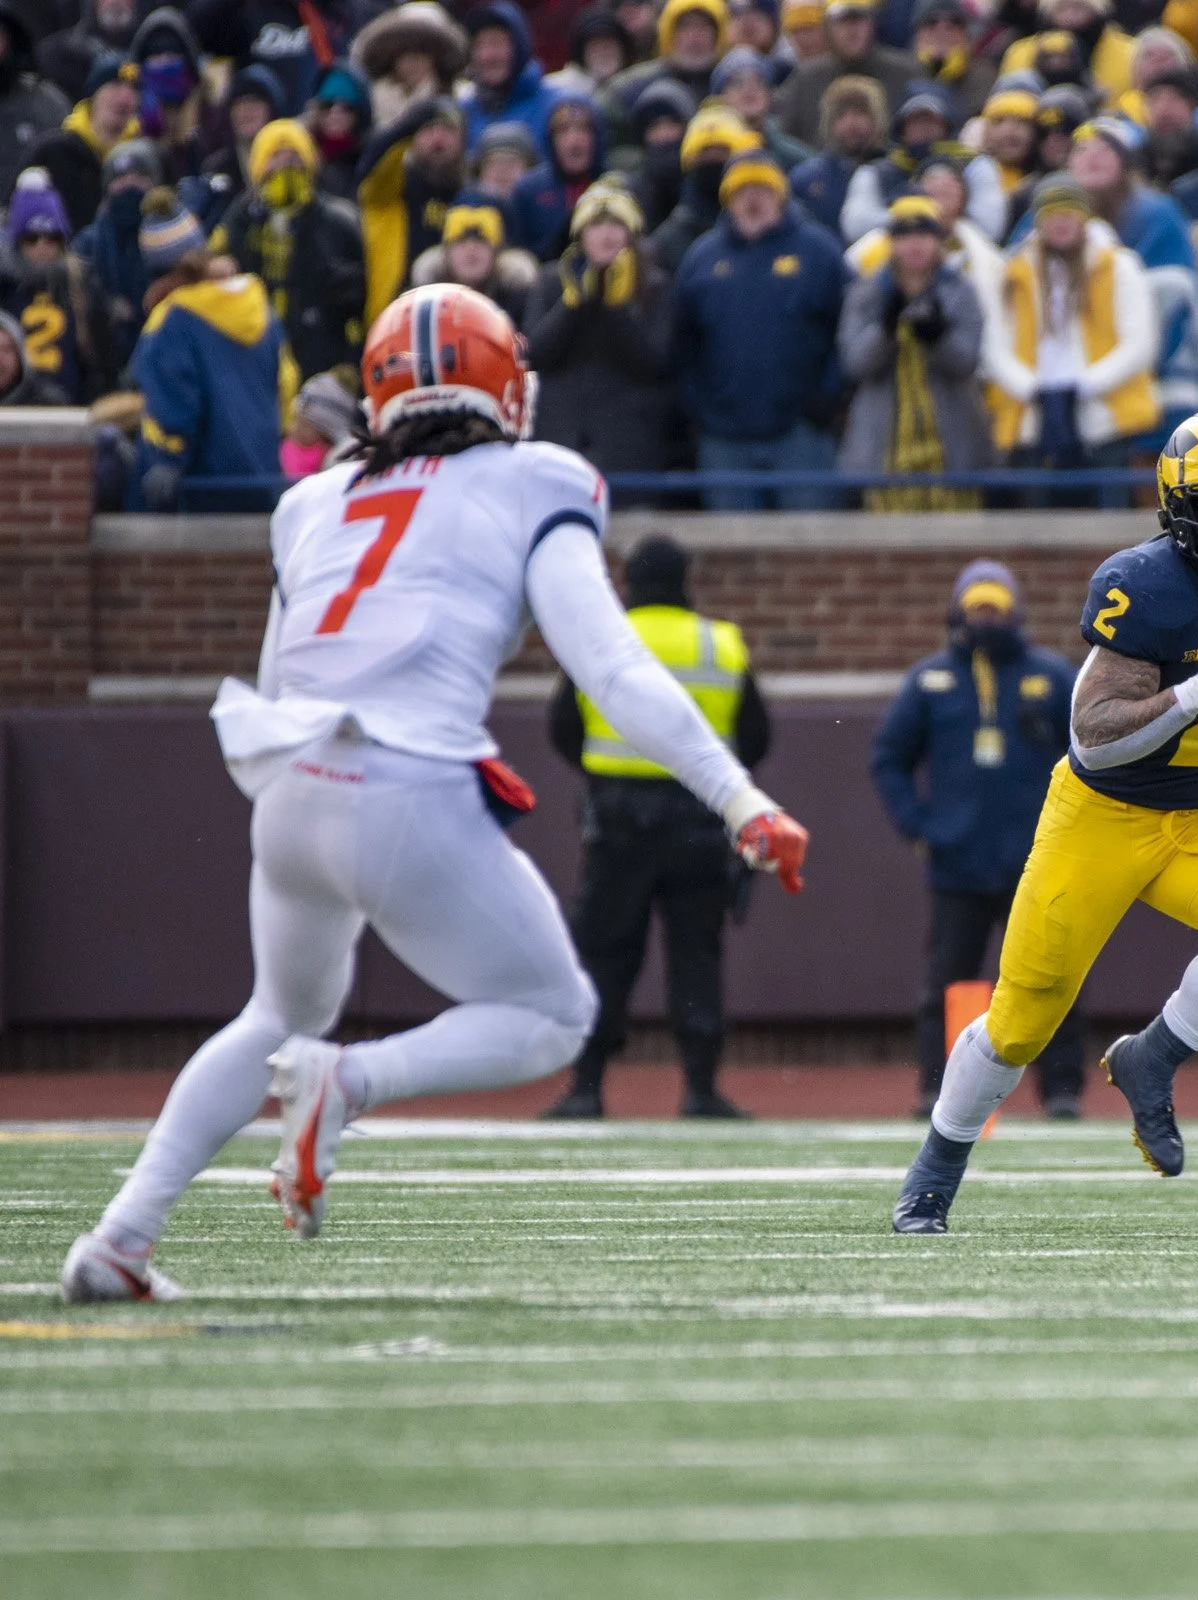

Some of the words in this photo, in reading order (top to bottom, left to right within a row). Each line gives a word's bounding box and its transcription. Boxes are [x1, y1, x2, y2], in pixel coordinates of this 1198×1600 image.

[22, 303, 65, 370] 2
[313, 486, 426, 635] 7
[1092, 587, 1131, 641] 2
